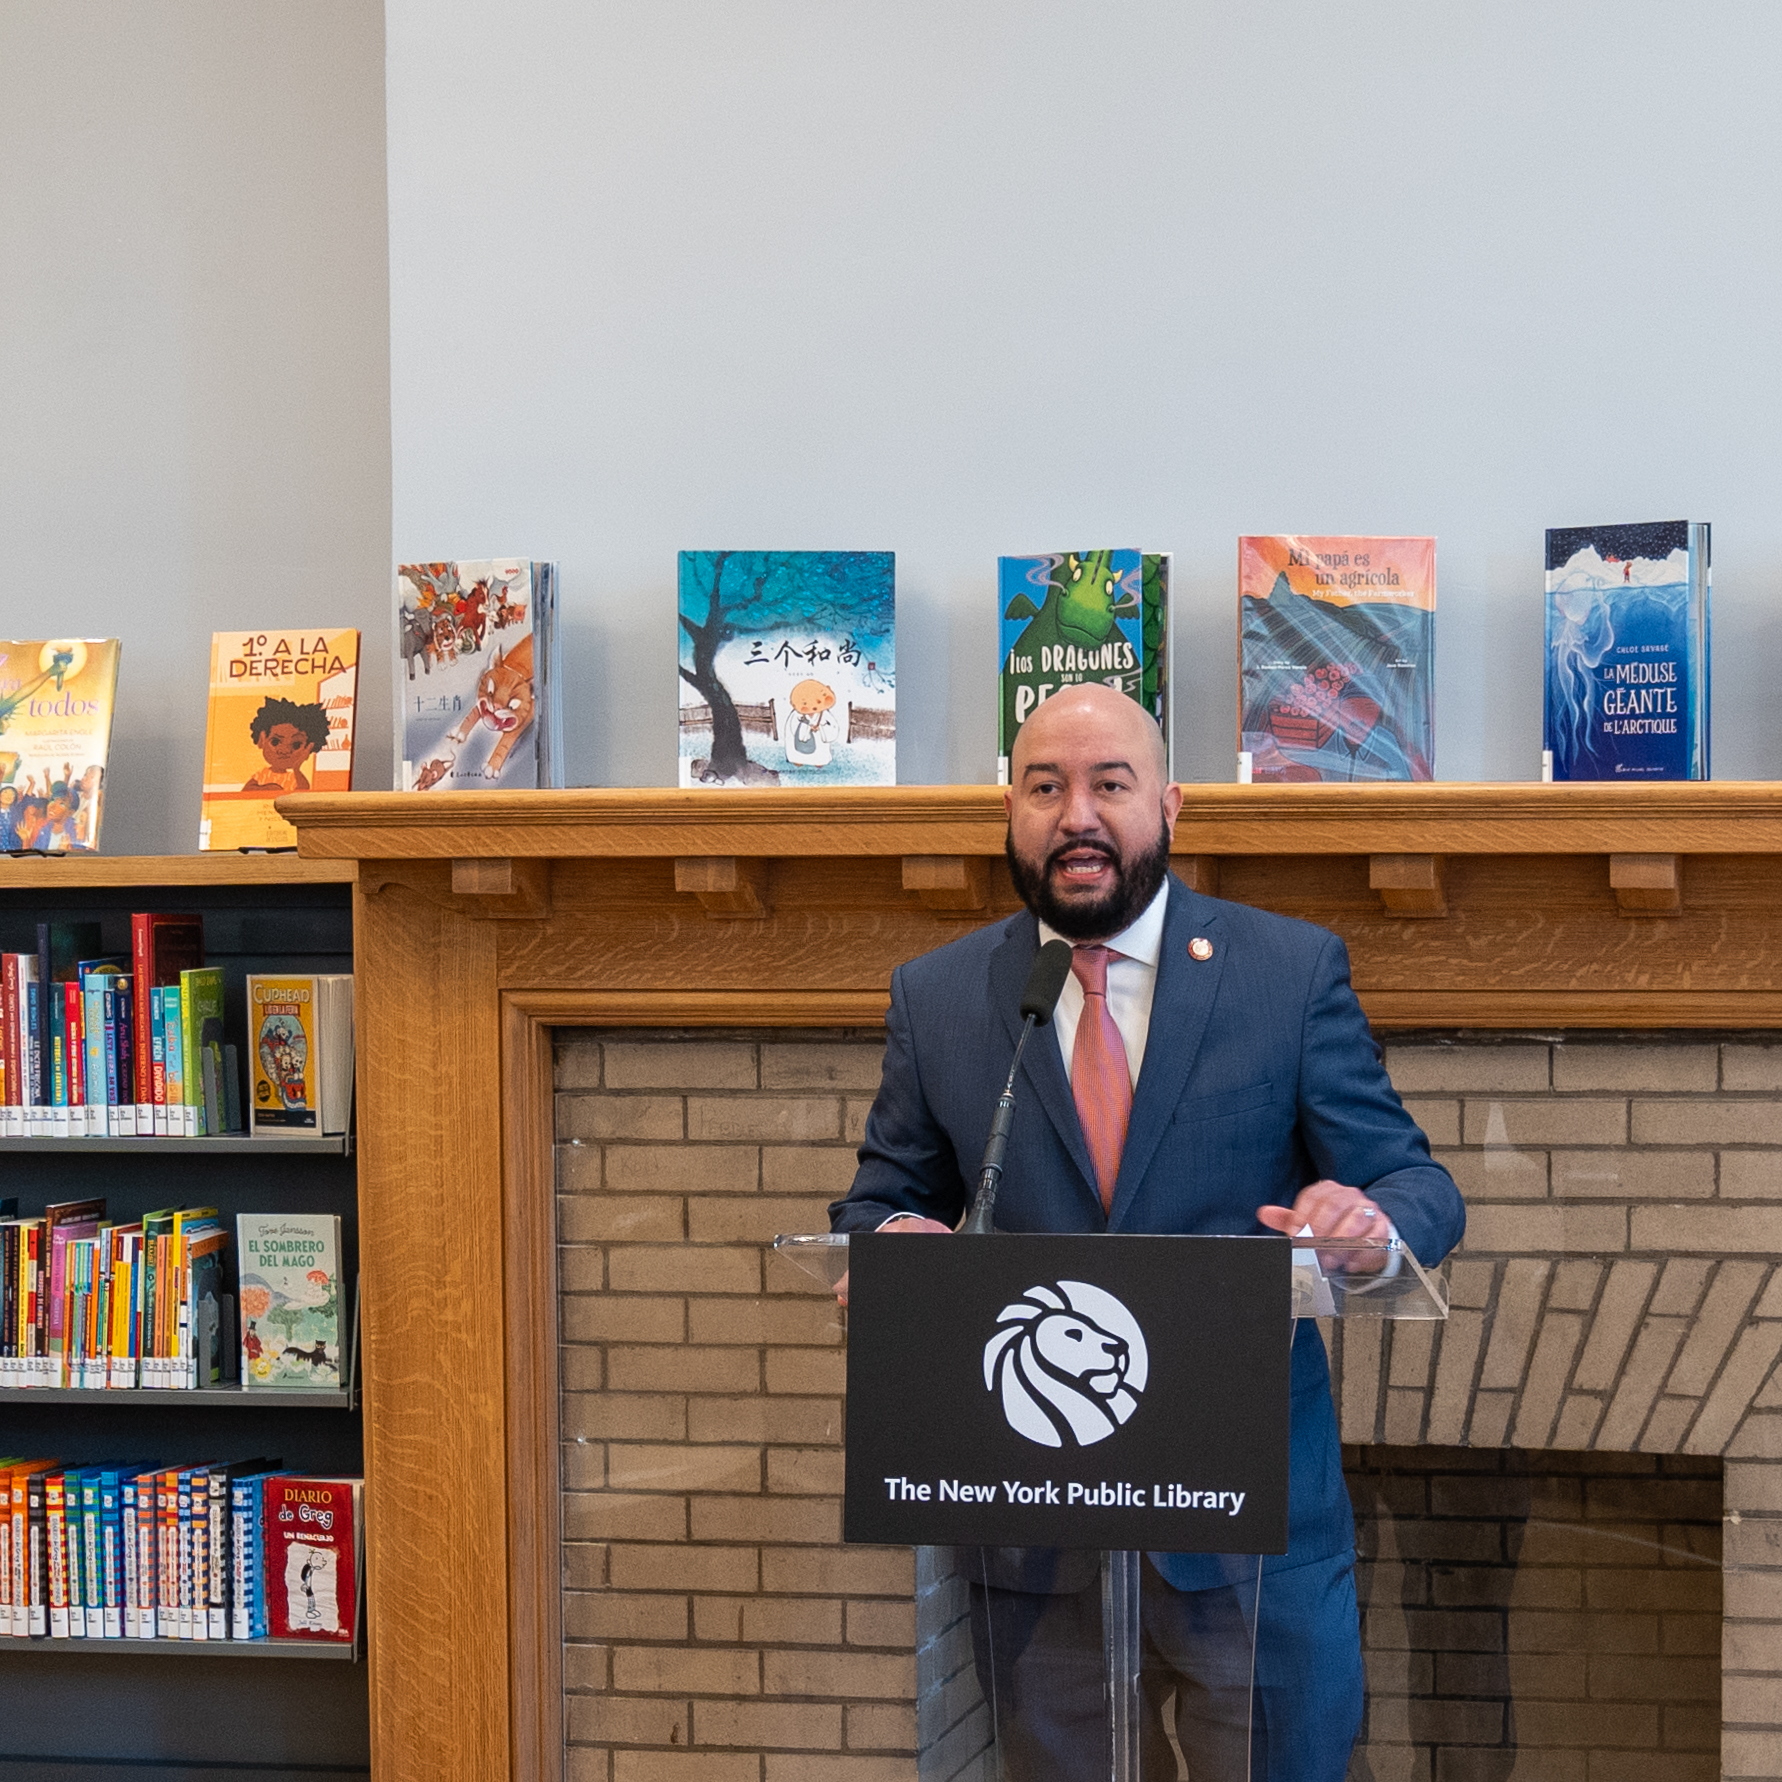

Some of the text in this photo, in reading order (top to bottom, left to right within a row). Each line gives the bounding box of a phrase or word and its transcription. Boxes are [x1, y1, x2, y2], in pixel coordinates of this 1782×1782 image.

[1288, 549, 1371, 570] Mi papá es
[1315, 567, 1400, 589] un agrícola
[273, 639, 291, 656] A
[300, 637, 329, 655] LA
[743, 638, 863, 668] 三个和尚
[1640, 644, 1669, 653] SAVAGE
[229, 655, 347, 678] DERECHA
[1041, 642, 1134, 673] DRAGONES
[1061, 673, 1083, 683] SON LO
[1604, 666, 1615, 680] LA
[28, 691, 99, 717] todos
[414, 695, 463, 712] 十二生肖
[1603, 686, 1677, 715] GÉANTE
[1604, 718, 1677, 735] DE L'ARCTIQUE
[253, 983, 310, 1004] CUPHEAD
[152, 1036, 163, 1061] EFRÉN
[152, 1066, 164, 1101] DIVIDIDO
[249, 1240, 324, 1253] EL SOMBRERO
[260, 1255, 315, 1267] DEL MAGO
[284, 1488, 332, 1504] DIARIO
[884, 1477, 1246, 1517] The New York Public Library
[279, 1504, 333, 1529] de Greg
